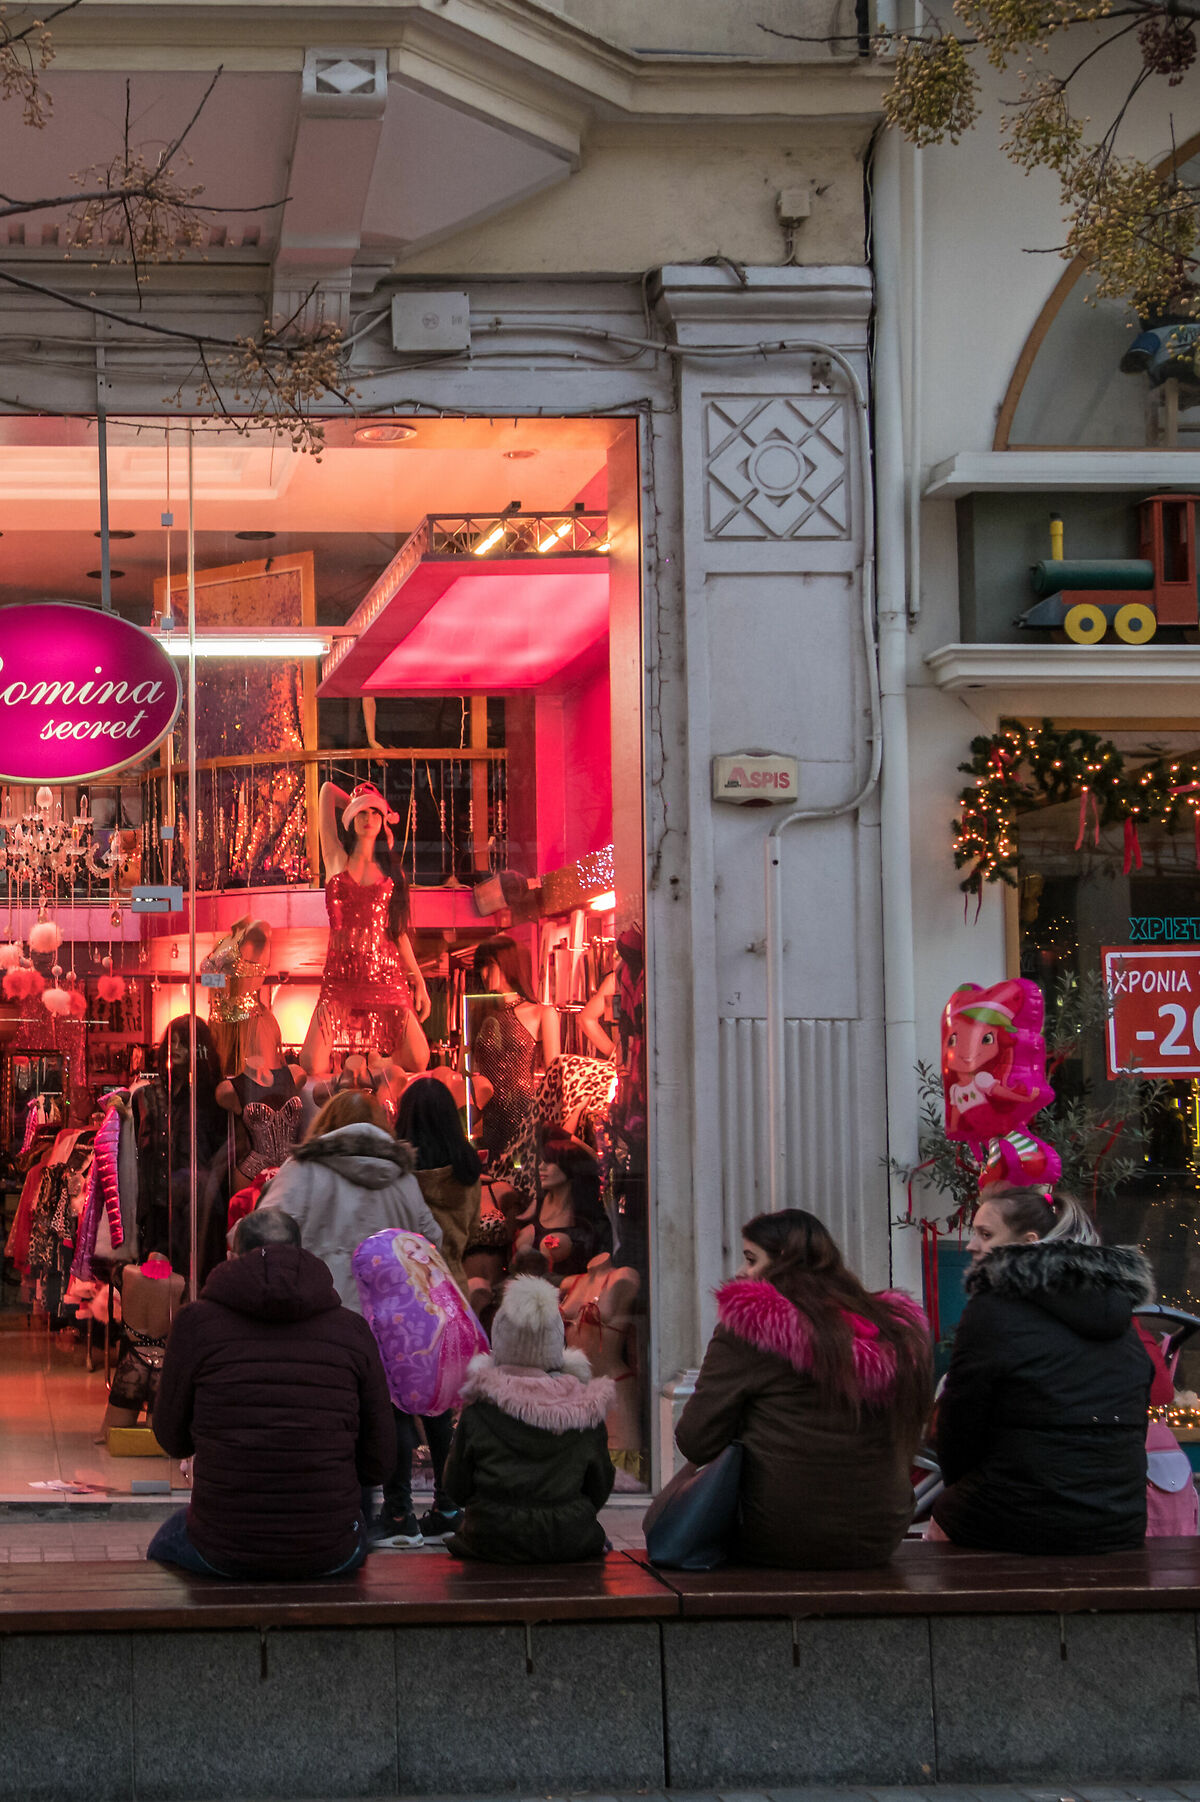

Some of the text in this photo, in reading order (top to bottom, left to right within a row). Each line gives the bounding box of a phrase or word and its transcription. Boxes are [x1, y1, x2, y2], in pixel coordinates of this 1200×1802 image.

[39, 709, 149, 741] secret
[726, 767, 791, 789] ASPIS
[1114, 969, 1192, 994] ΧΡΟΝΙΑ
[1135, 1003, 1200, 1056] -2
